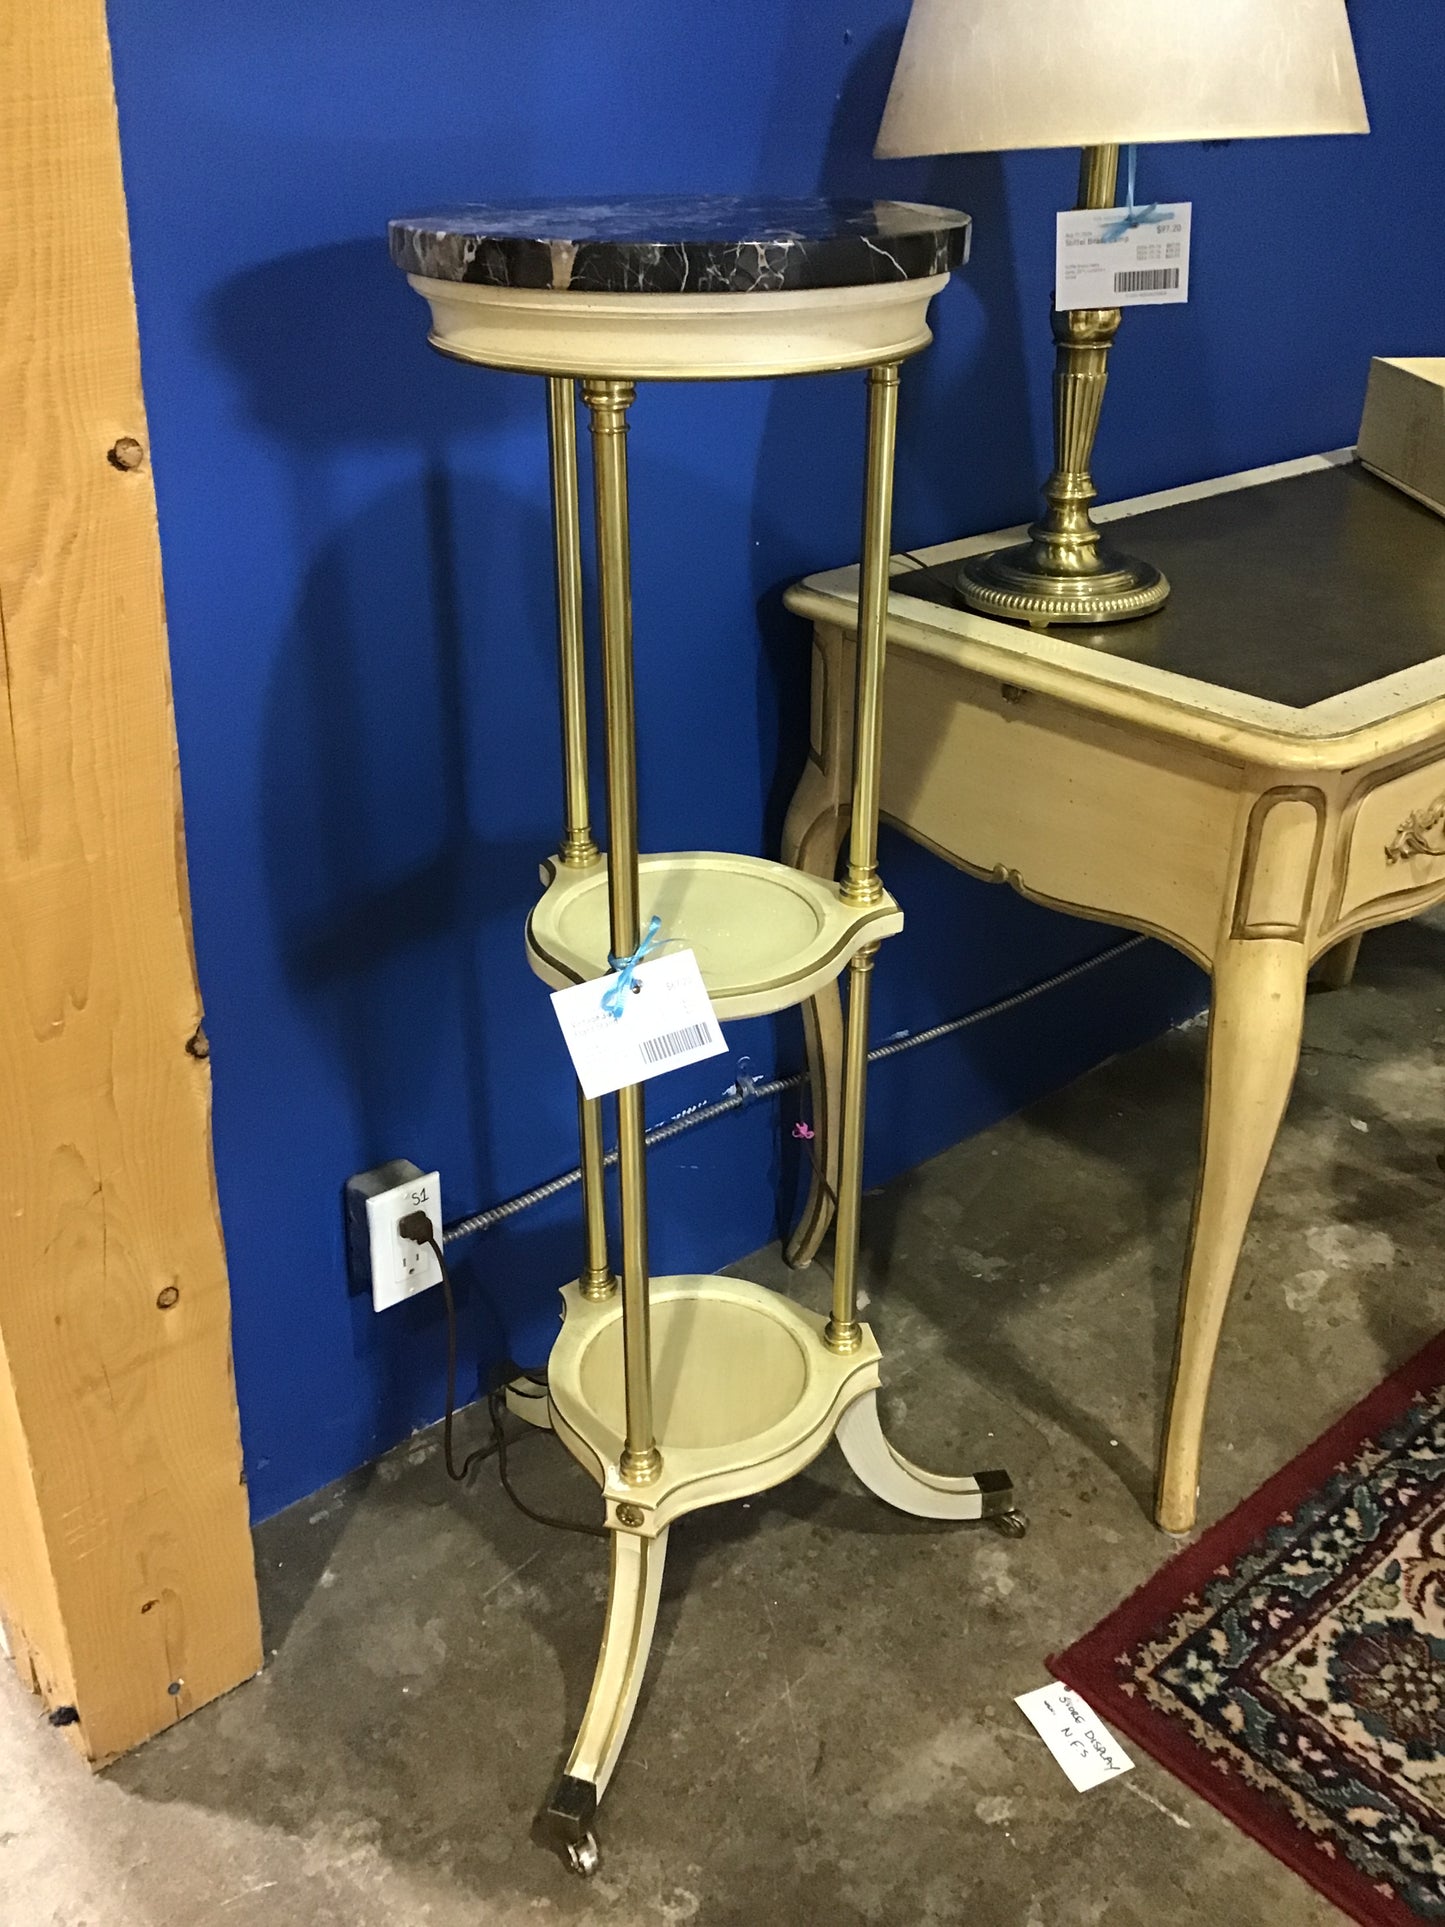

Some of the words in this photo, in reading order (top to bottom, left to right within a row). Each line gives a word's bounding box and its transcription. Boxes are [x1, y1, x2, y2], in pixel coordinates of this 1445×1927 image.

[411, 1187, 430, 1206] S1
[1058, 1695, 1086, 1724] STORE
[1084, 1729, 1121, 1771] DISPLAY
